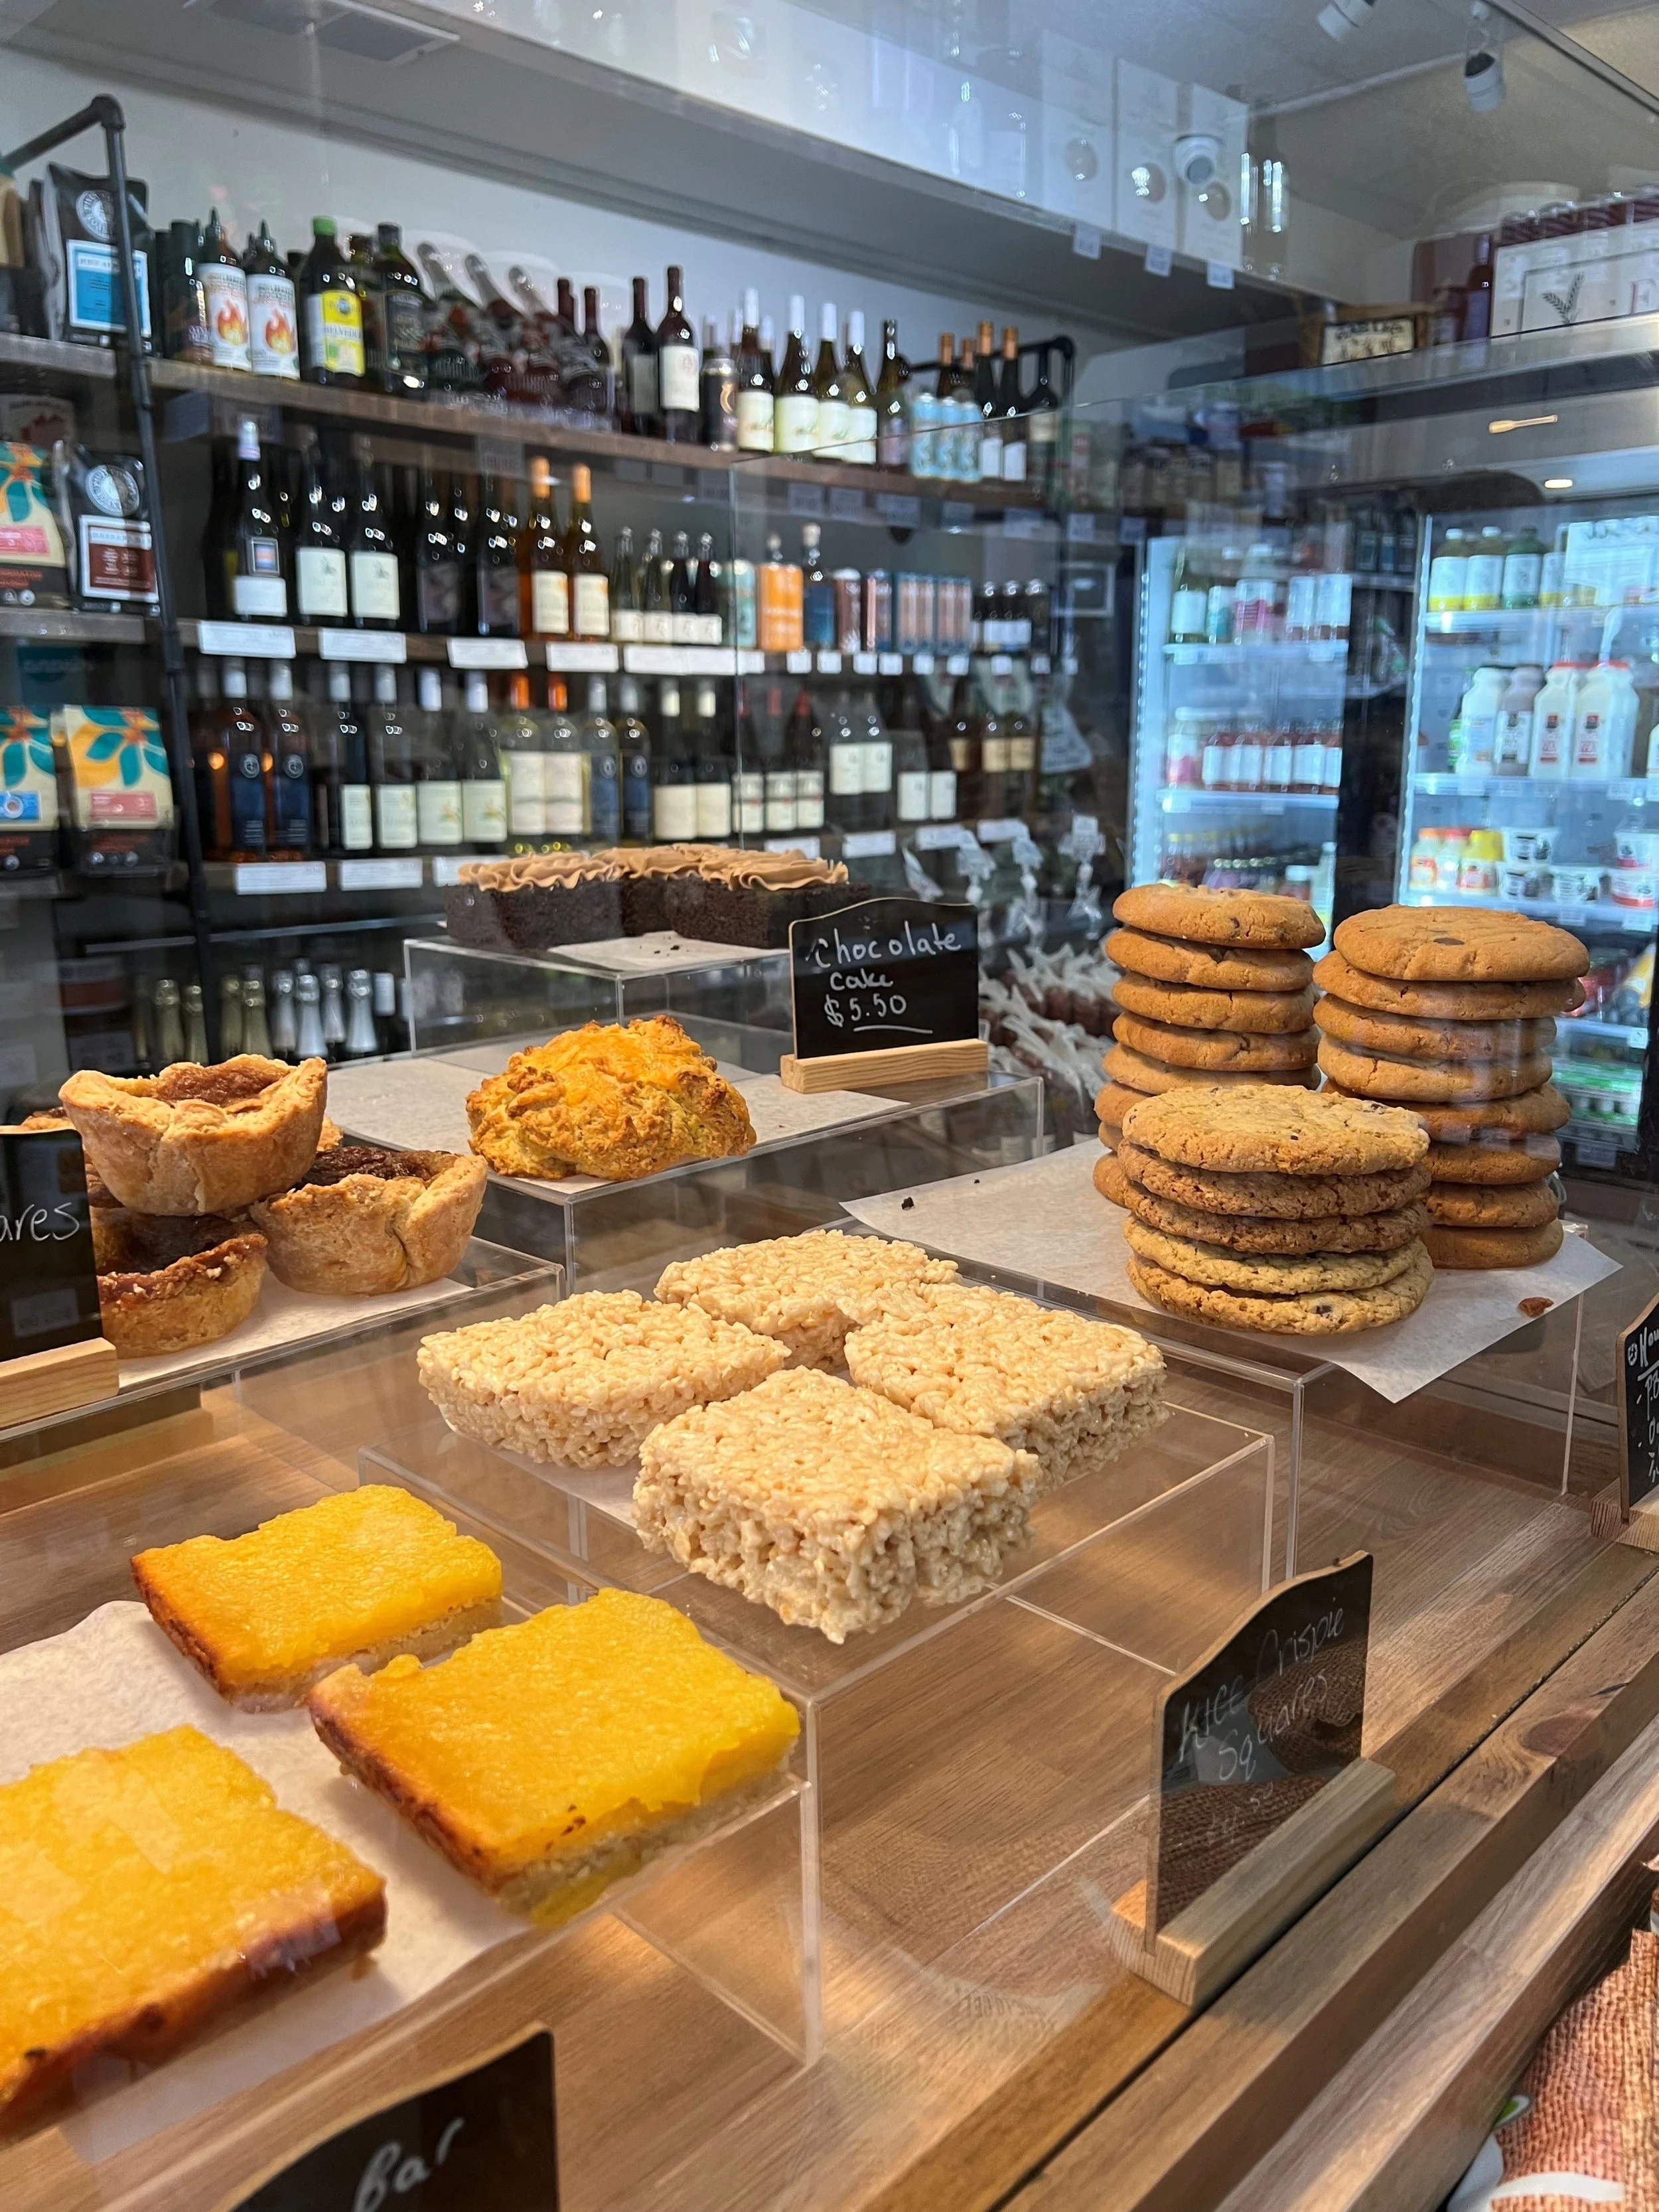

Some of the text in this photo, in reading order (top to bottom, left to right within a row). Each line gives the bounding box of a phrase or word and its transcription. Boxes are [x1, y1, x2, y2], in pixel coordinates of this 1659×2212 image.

[806, 921, 962, 968] Chocolate
[824, 994, 907, 1027] $5.50
[1218, 1670, 1328, 1781] Squares
[353, 2118, 464, 2212] Bar
